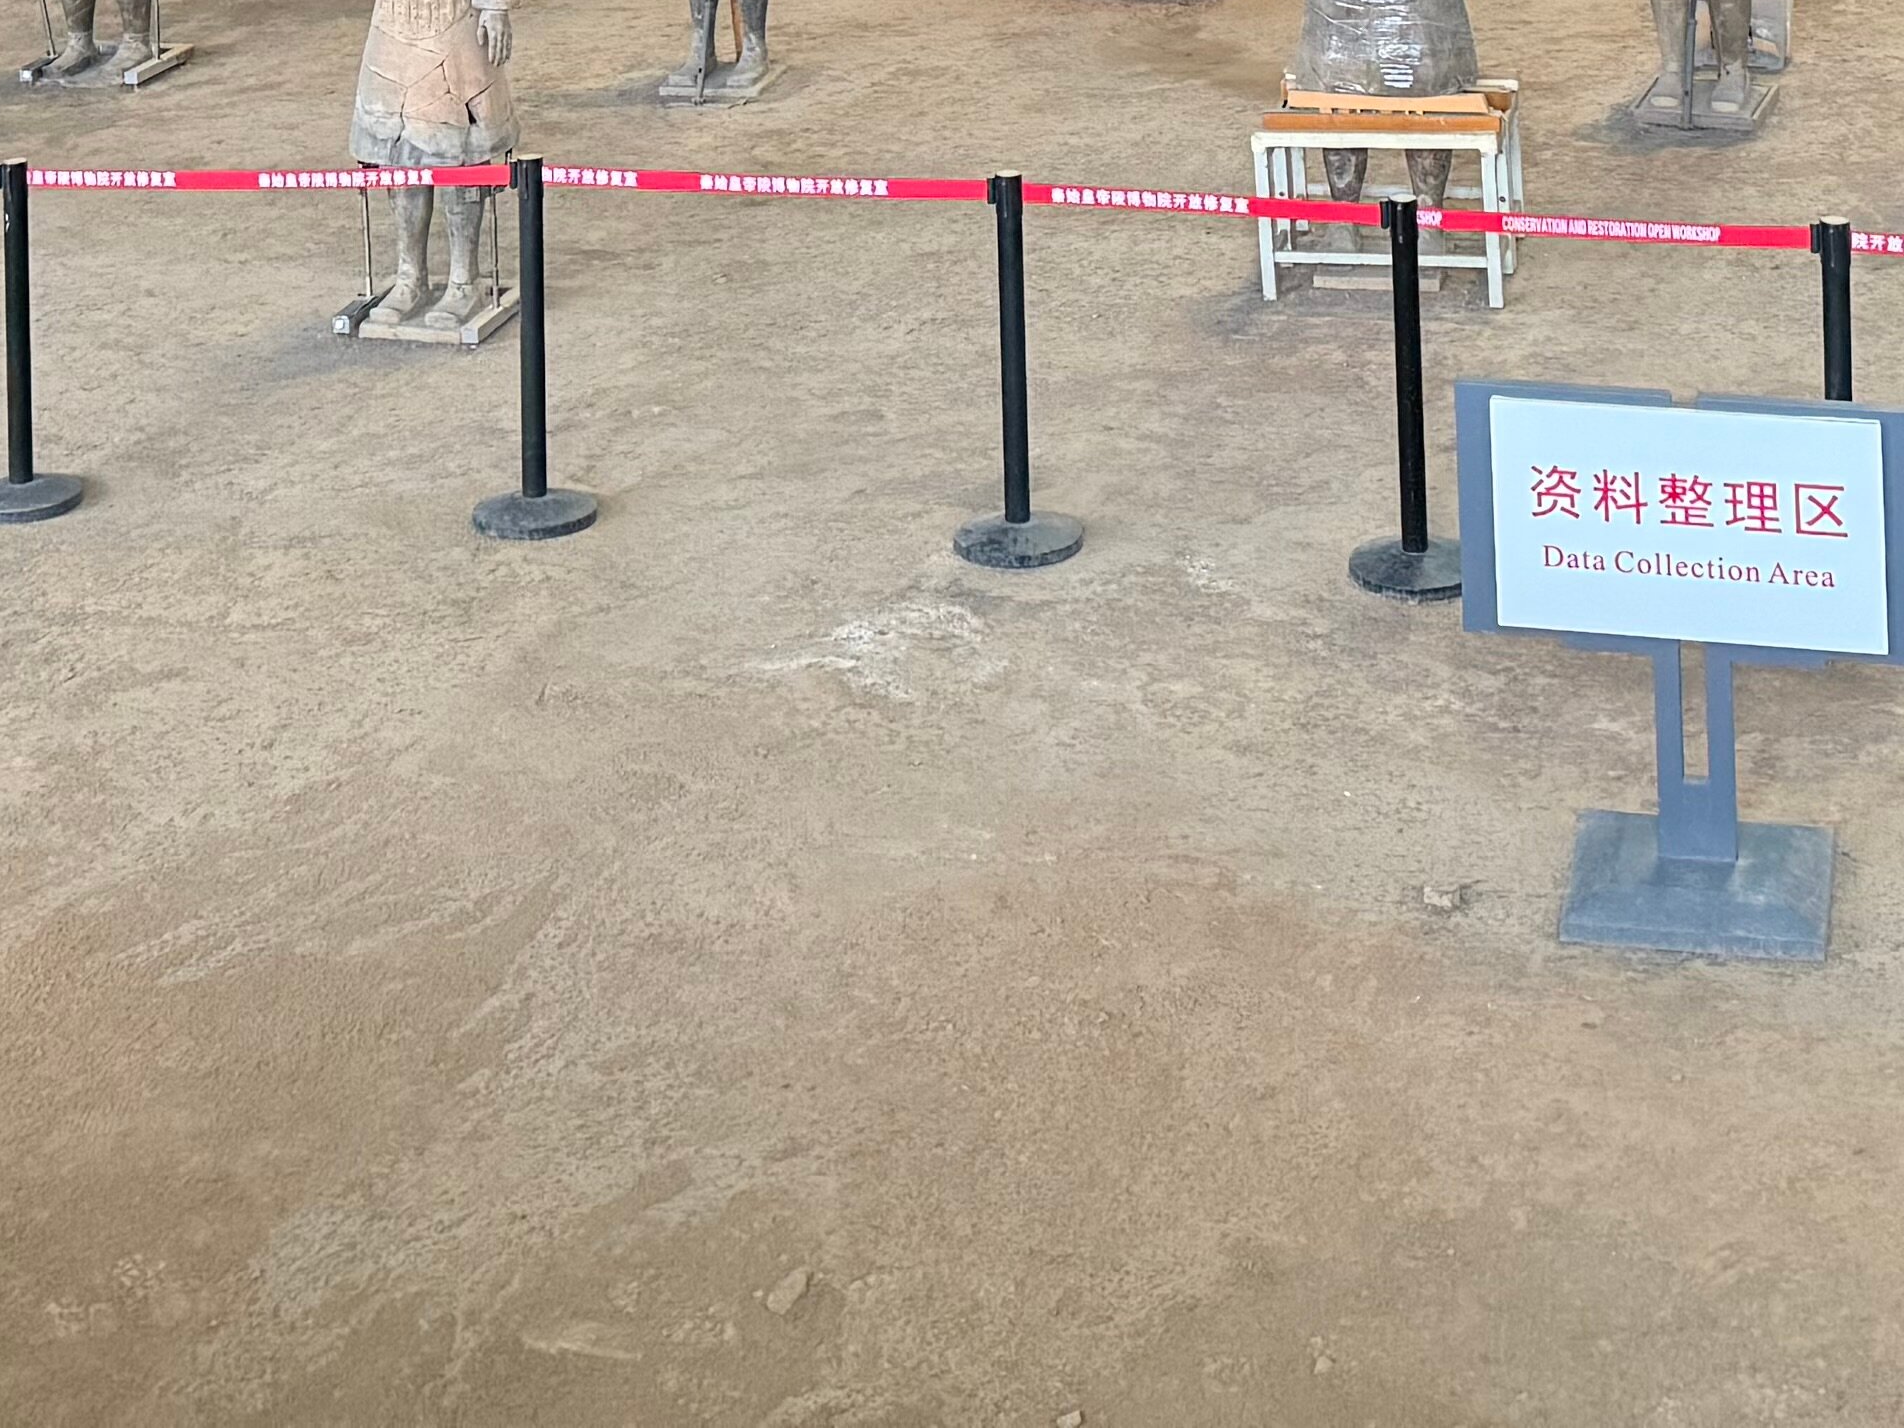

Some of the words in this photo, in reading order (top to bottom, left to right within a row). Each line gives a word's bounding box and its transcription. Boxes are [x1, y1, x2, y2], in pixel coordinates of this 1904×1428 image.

[1529, 464, 1849, 539] 资料整理区
[1543, 545, 1606, 572] Data
[1614, 550, 1761, 583] Collection
[1768, 562, 1836, 589] Area
